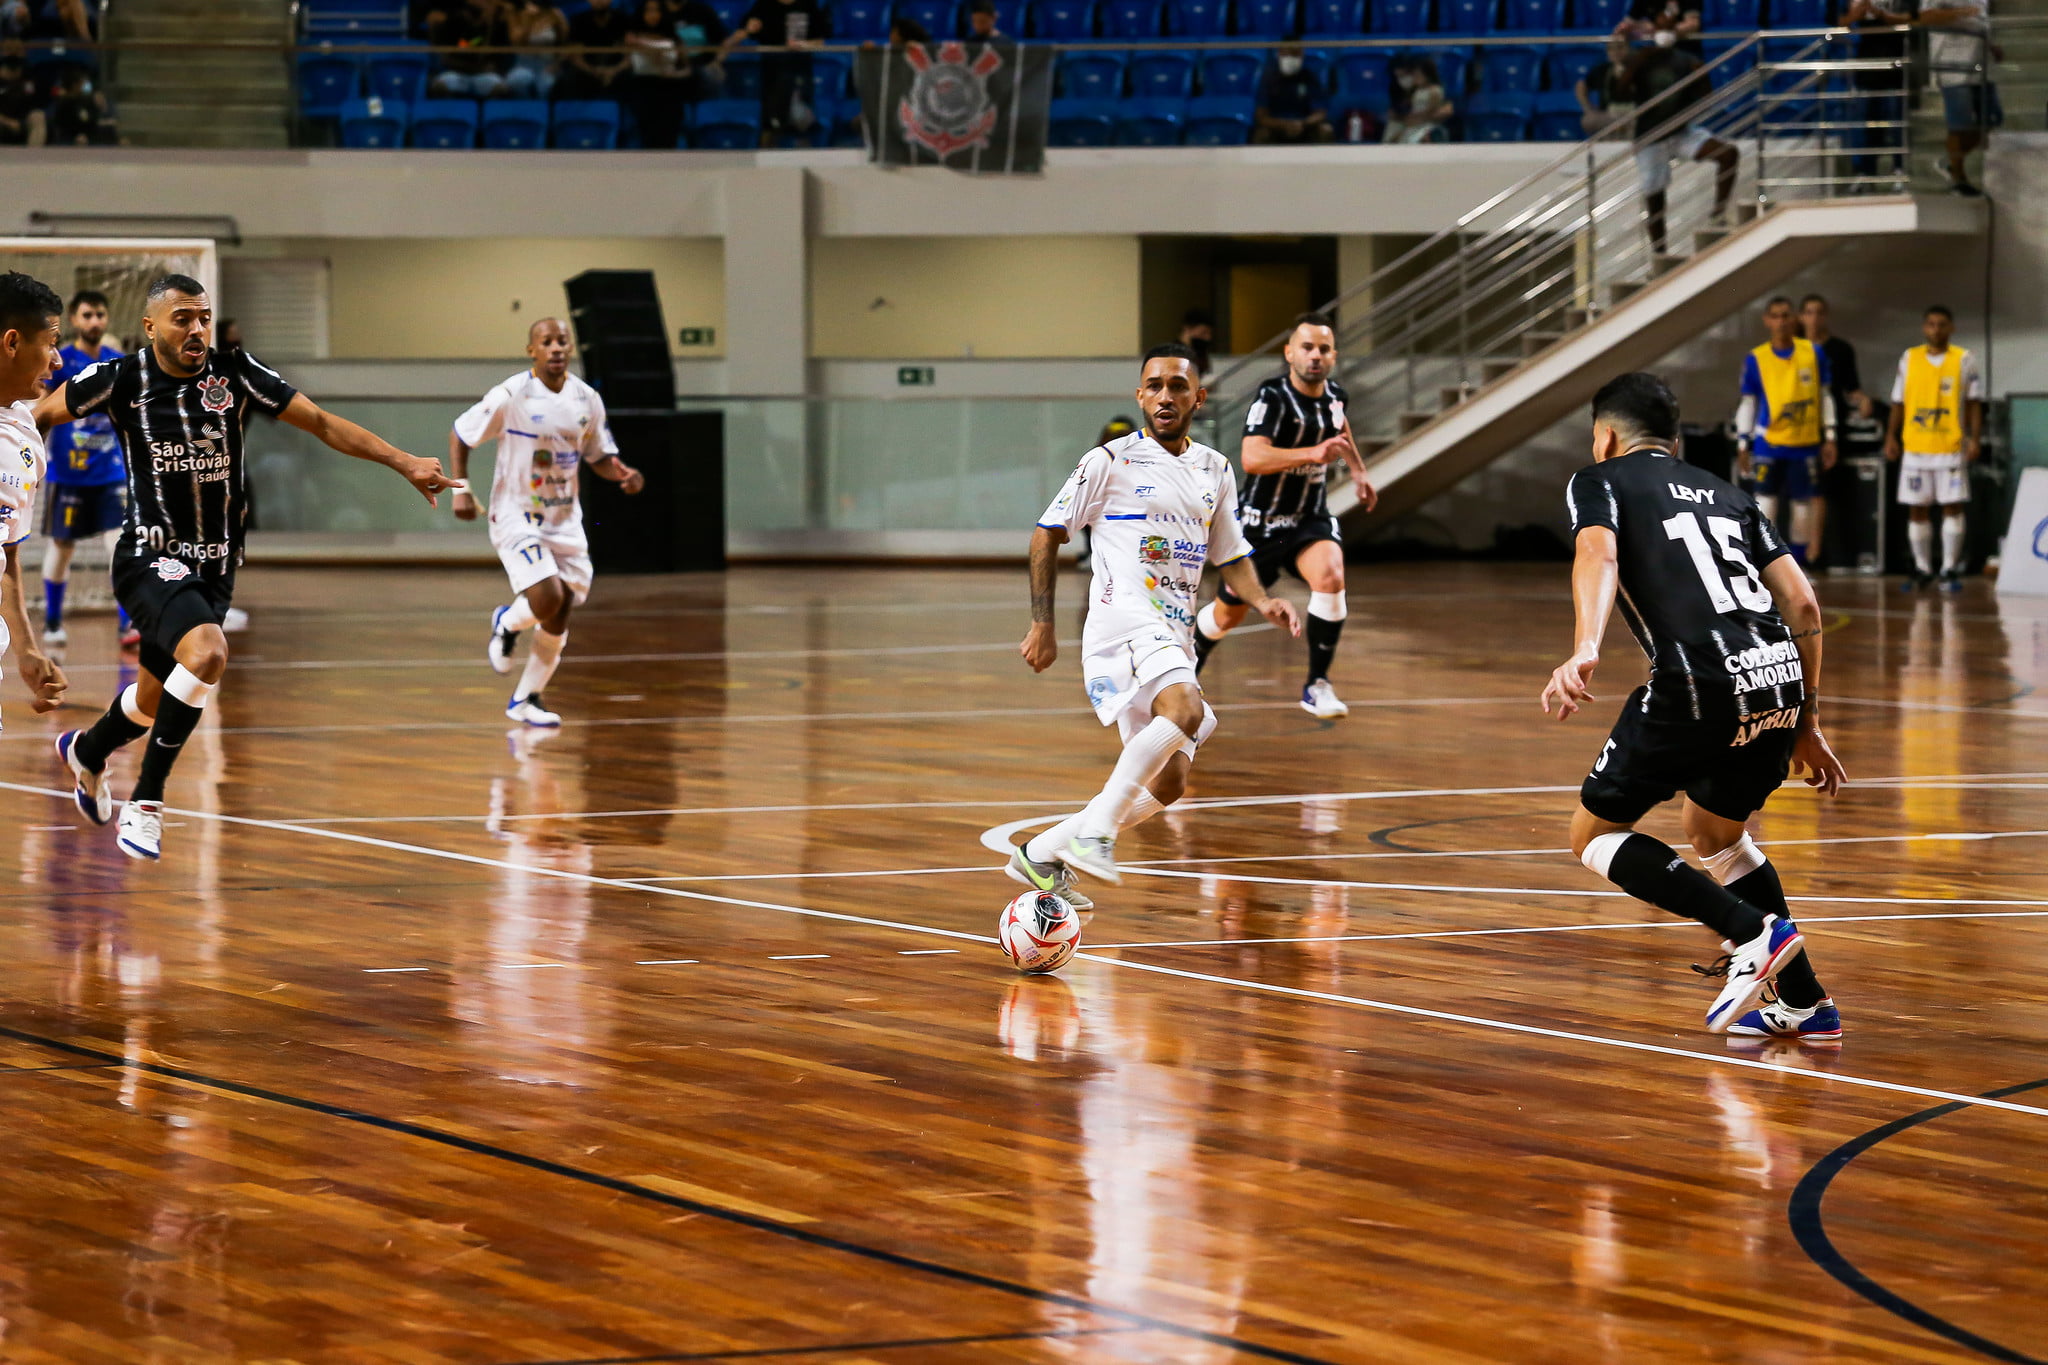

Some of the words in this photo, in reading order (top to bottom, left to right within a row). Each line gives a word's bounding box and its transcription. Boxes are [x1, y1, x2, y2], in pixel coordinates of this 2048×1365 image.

[150, 440, 184, 457] São
[152, 453, 231, 473] Cristóvão
[198, 469, 231, 484] saúde
[1667, 482, 1715, 505] LEVY
[135, 525, 165, 557] 20
[1173, 538, 1193, 552] SÃO
[520, 544, 542, 565] 17
[1662, 511, 1773, 615] 15
